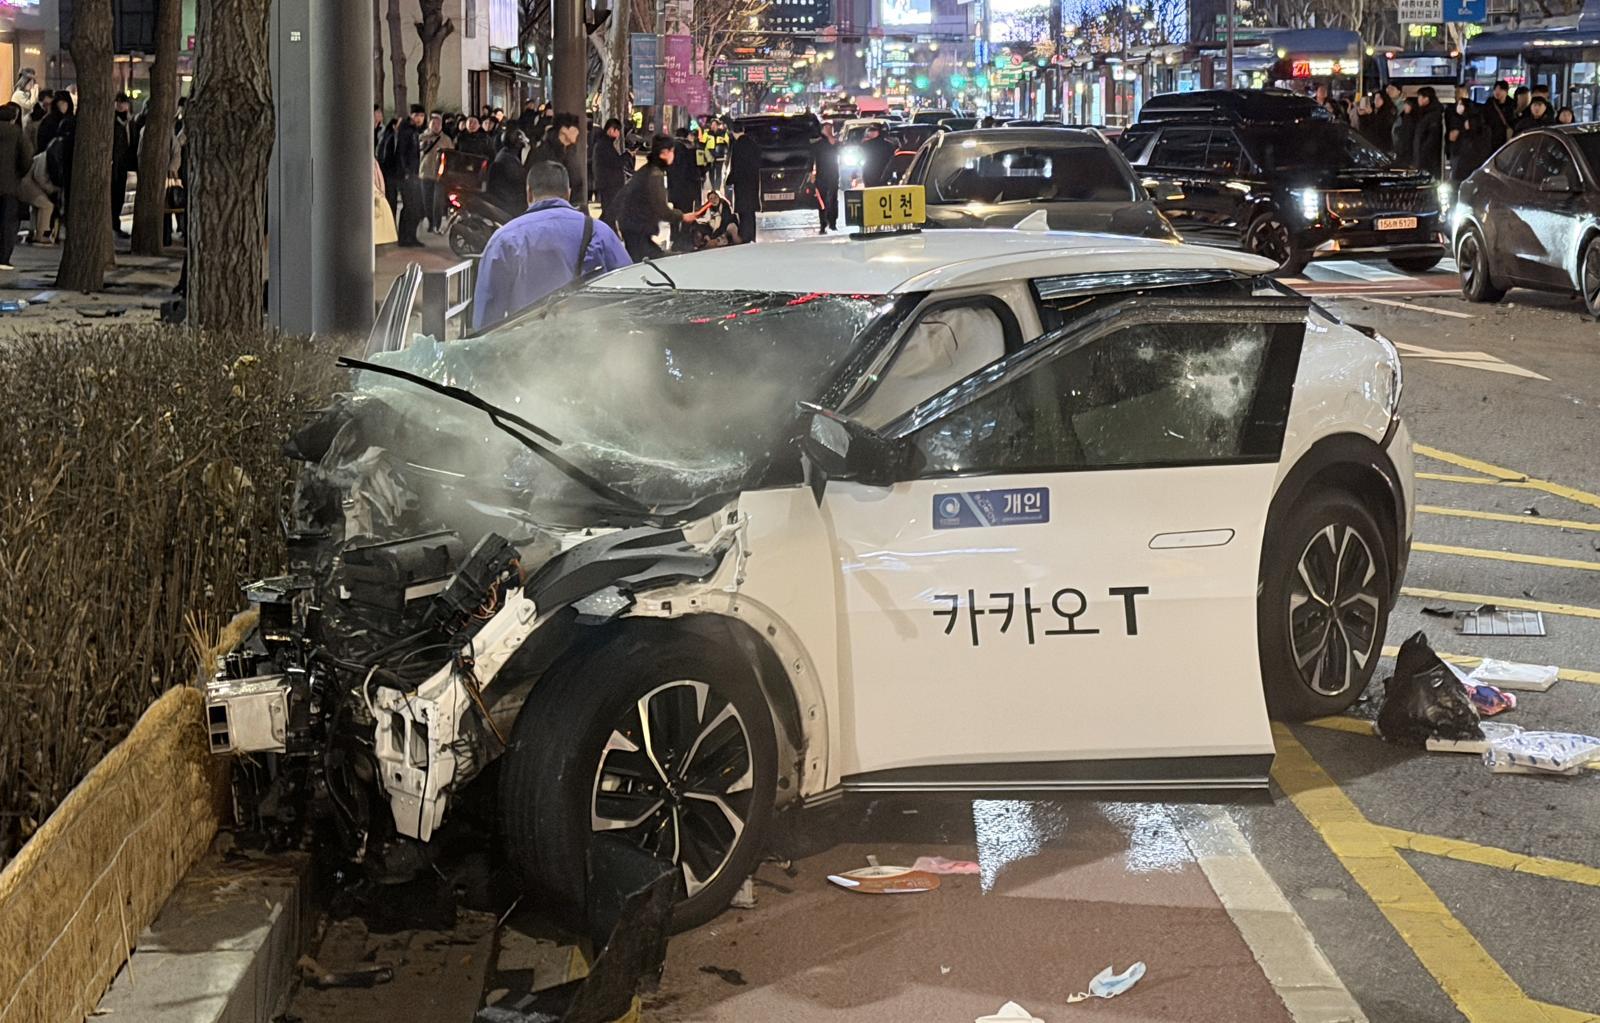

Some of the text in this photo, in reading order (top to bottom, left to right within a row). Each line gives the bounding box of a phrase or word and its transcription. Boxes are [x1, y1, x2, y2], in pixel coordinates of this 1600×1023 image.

[879, 193, 913, 219] 인천
[1003, 492, 1042, 514] 개인
[933, 586, 1149, 646] 카카오 T
